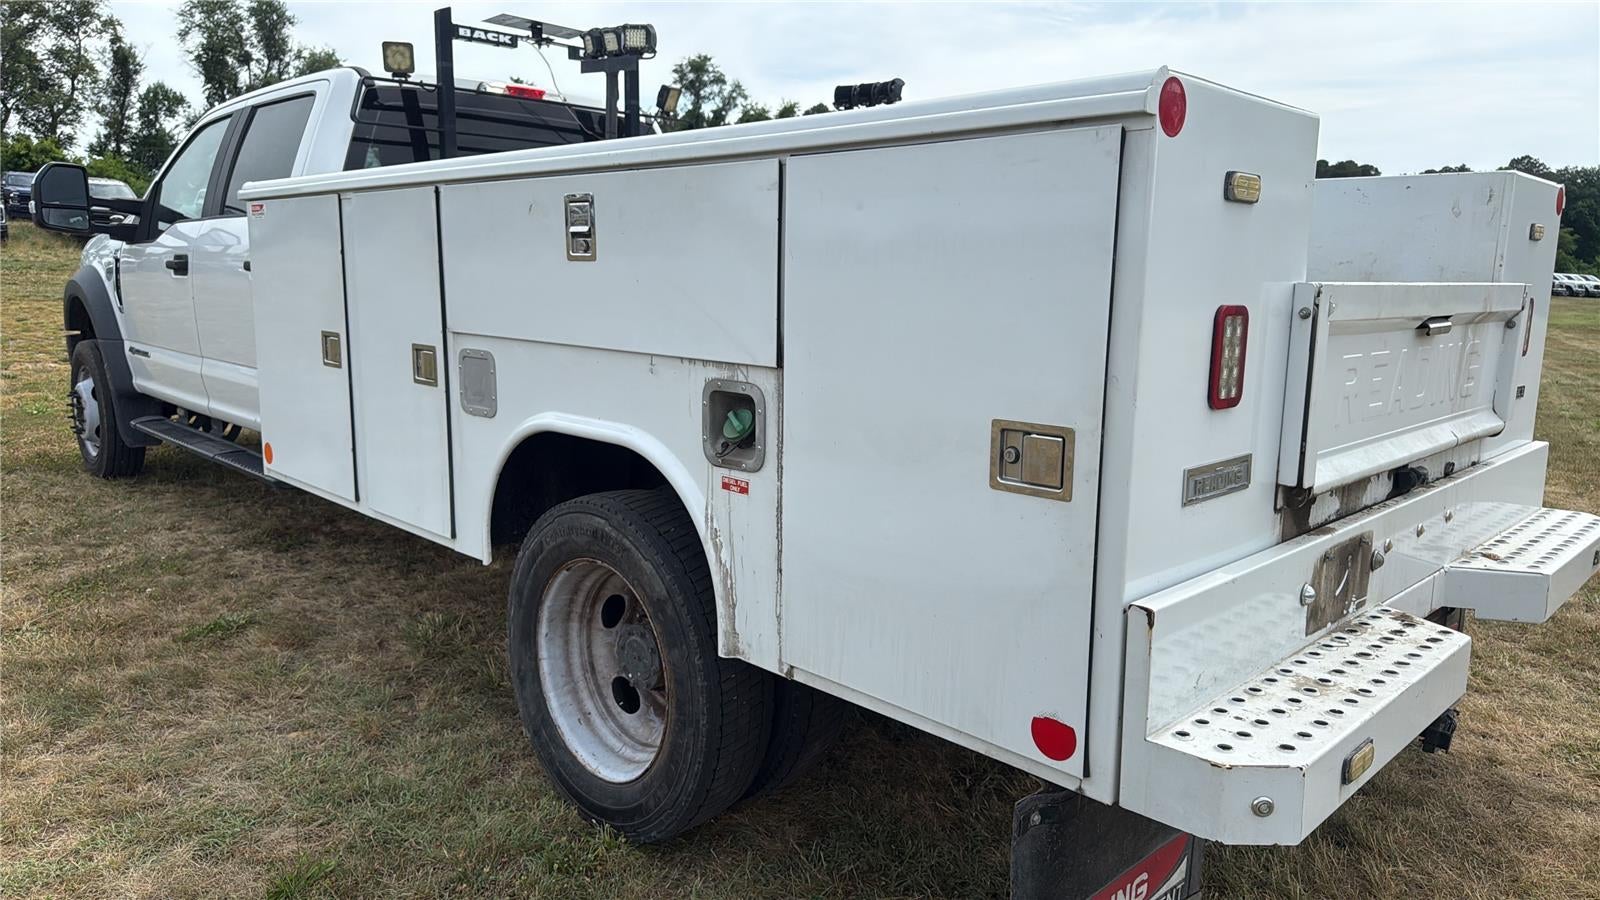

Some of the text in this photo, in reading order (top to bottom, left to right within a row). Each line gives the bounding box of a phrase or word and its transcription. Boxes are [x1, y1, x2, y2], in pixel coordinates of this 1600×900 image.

[458, 27, 512, 44] BACK
[1334, 339, 1482, 430] READING
[722, 476, 748, 488] DIESEL FUEL
[729, 485, 741, 493] ONLY
[1194, 467, 1244, 497] READING
